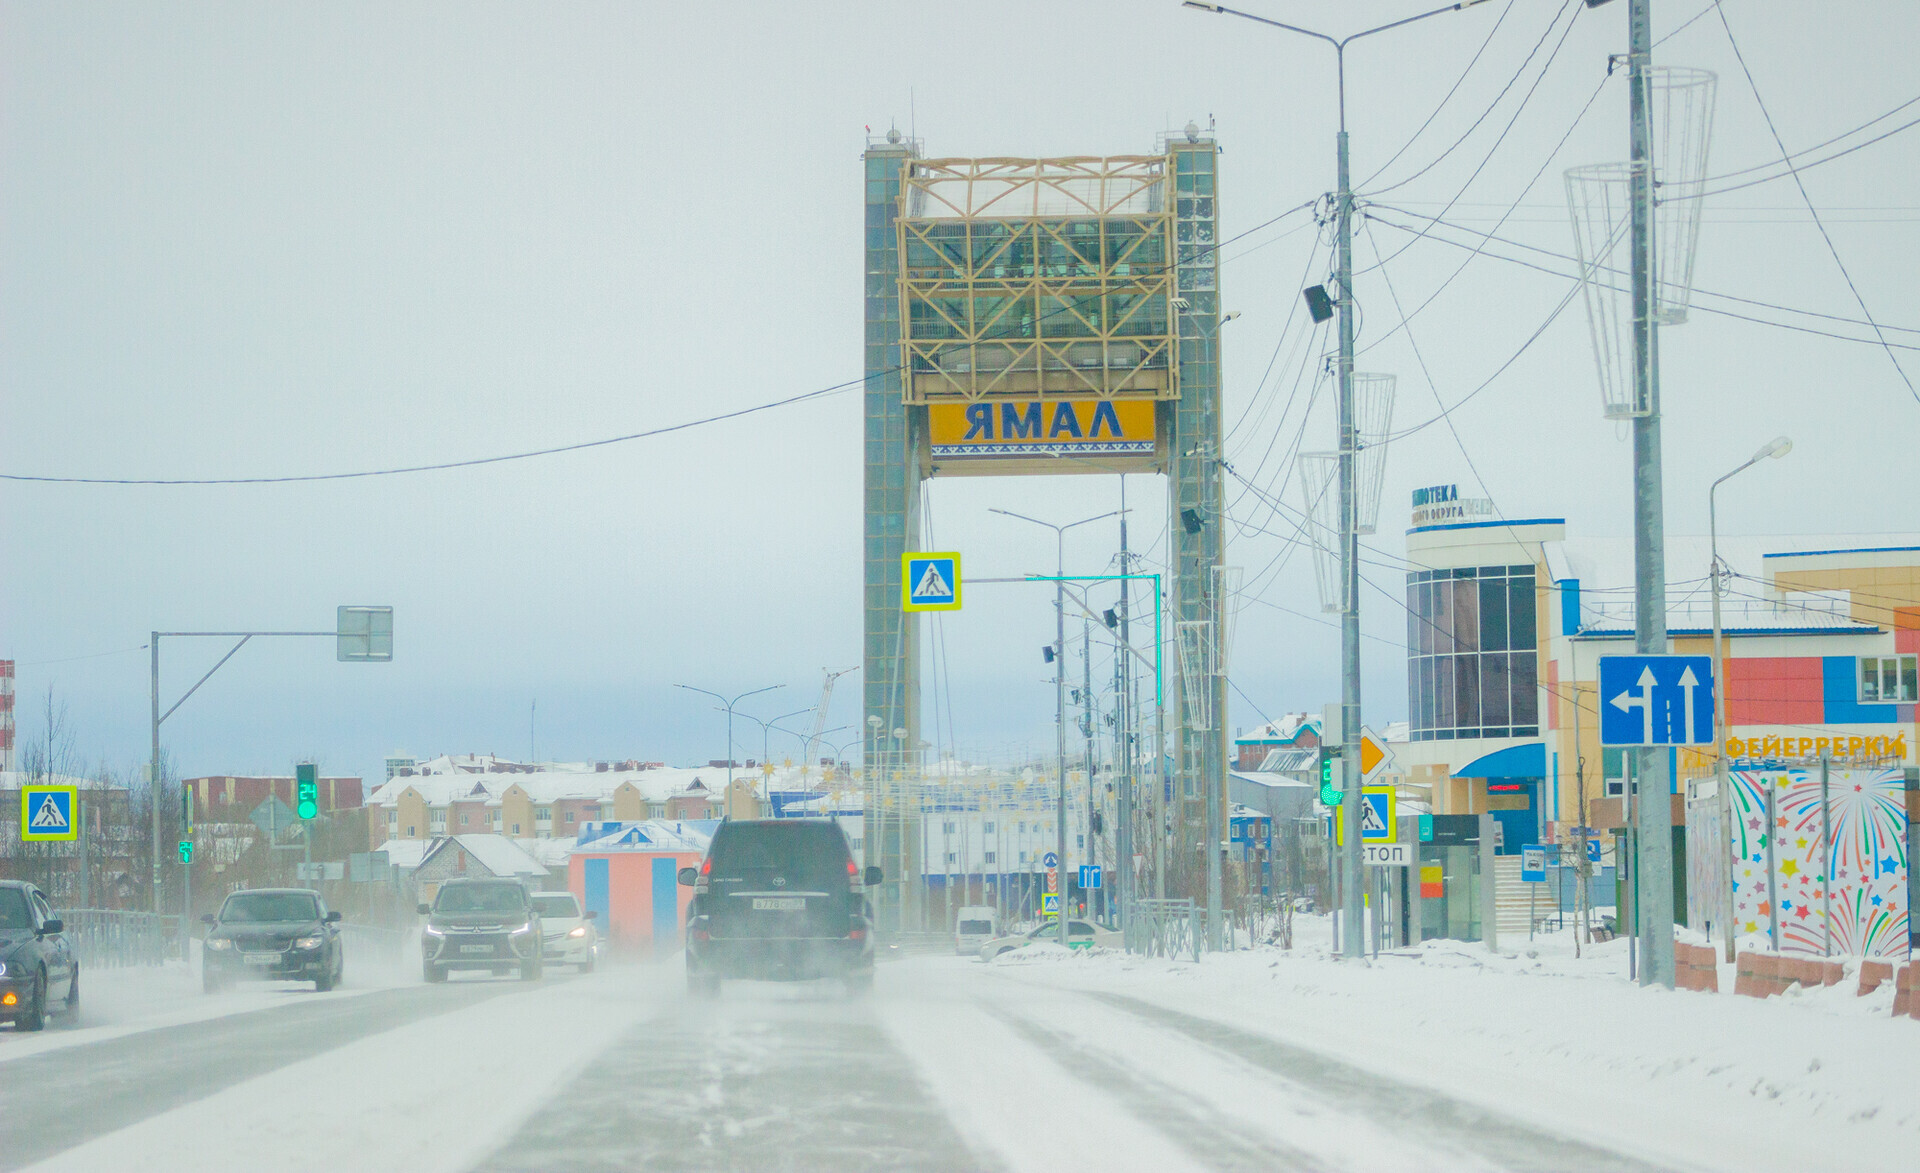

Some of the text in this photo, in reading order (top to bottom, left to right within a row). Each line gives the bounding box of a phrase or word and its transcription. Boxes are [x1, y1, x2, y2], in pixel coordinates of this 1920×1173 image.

[962, 401, 1123, 440] ЯМАЛ
[1431, 505, 1464, 520] ОКРУГА
[299, 783, 317, 800] 24
[179, 841, 193, 853] 24
